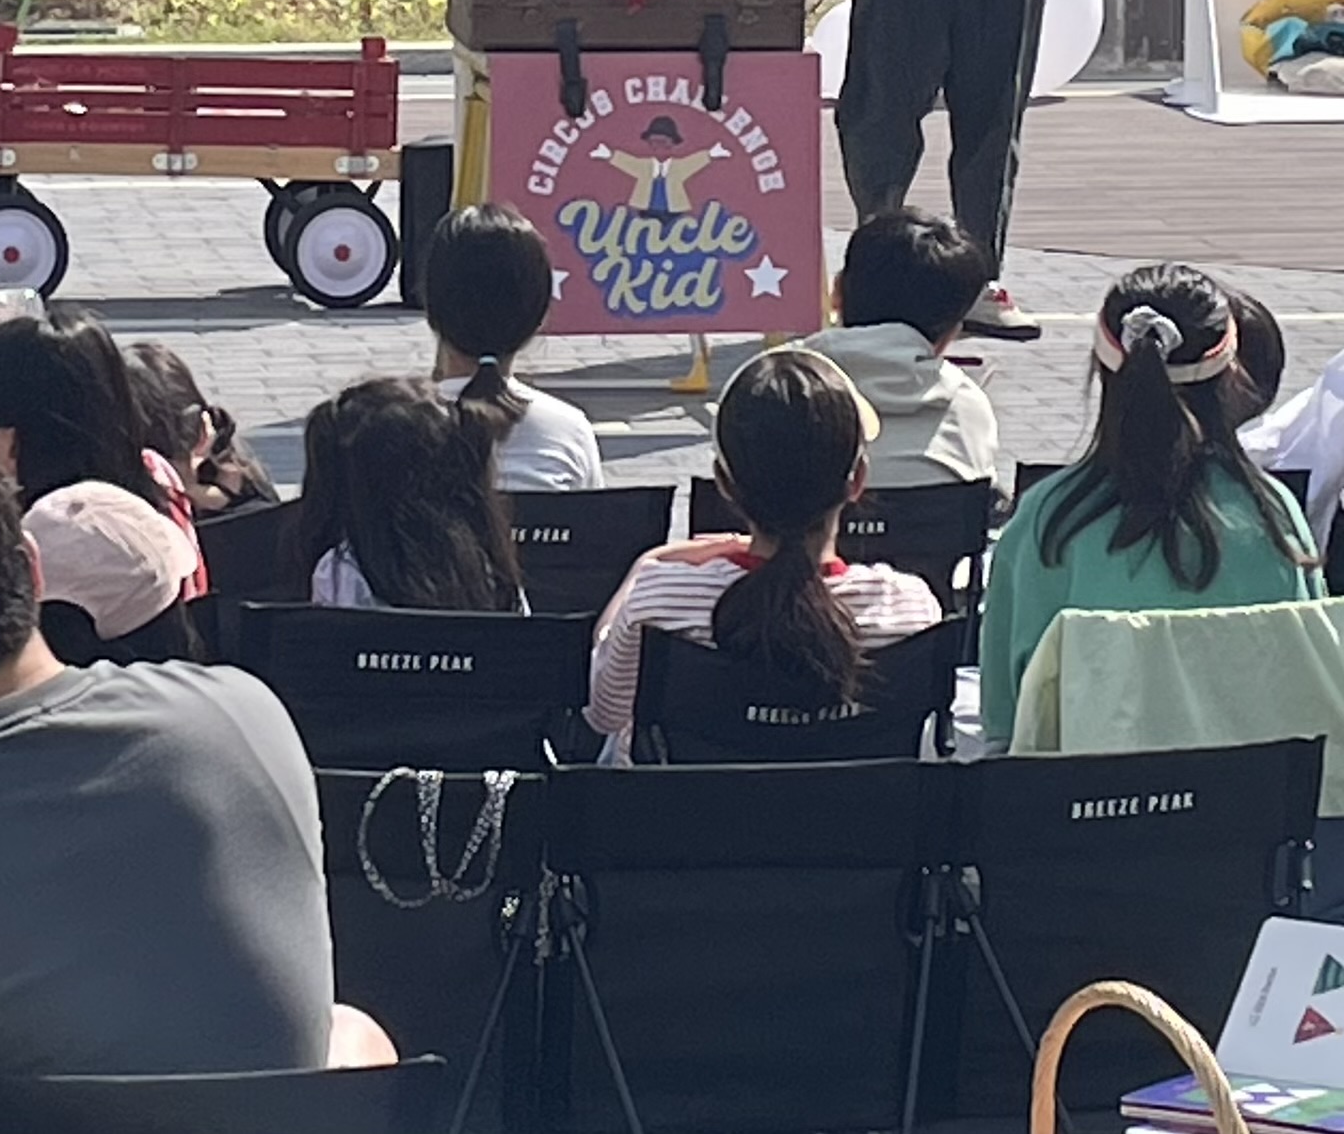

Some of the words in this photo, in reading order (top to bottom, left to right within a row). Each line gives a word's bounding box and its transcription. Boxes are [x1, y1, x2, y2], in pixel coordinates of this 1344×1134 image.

[558, 199, 755, 258] Uncle
[591, 254, 723, 314] Kid
[532, 527, 571, 542] PEAK
[847, 521, 886, 535] PEAK
[357, 652, 423, 671] BREEZE
[428, 654, 474, 672] PEAK
[1071, 796, 1140, 820] BREEZE
[1147, 791, 1195, 813] PEAK
